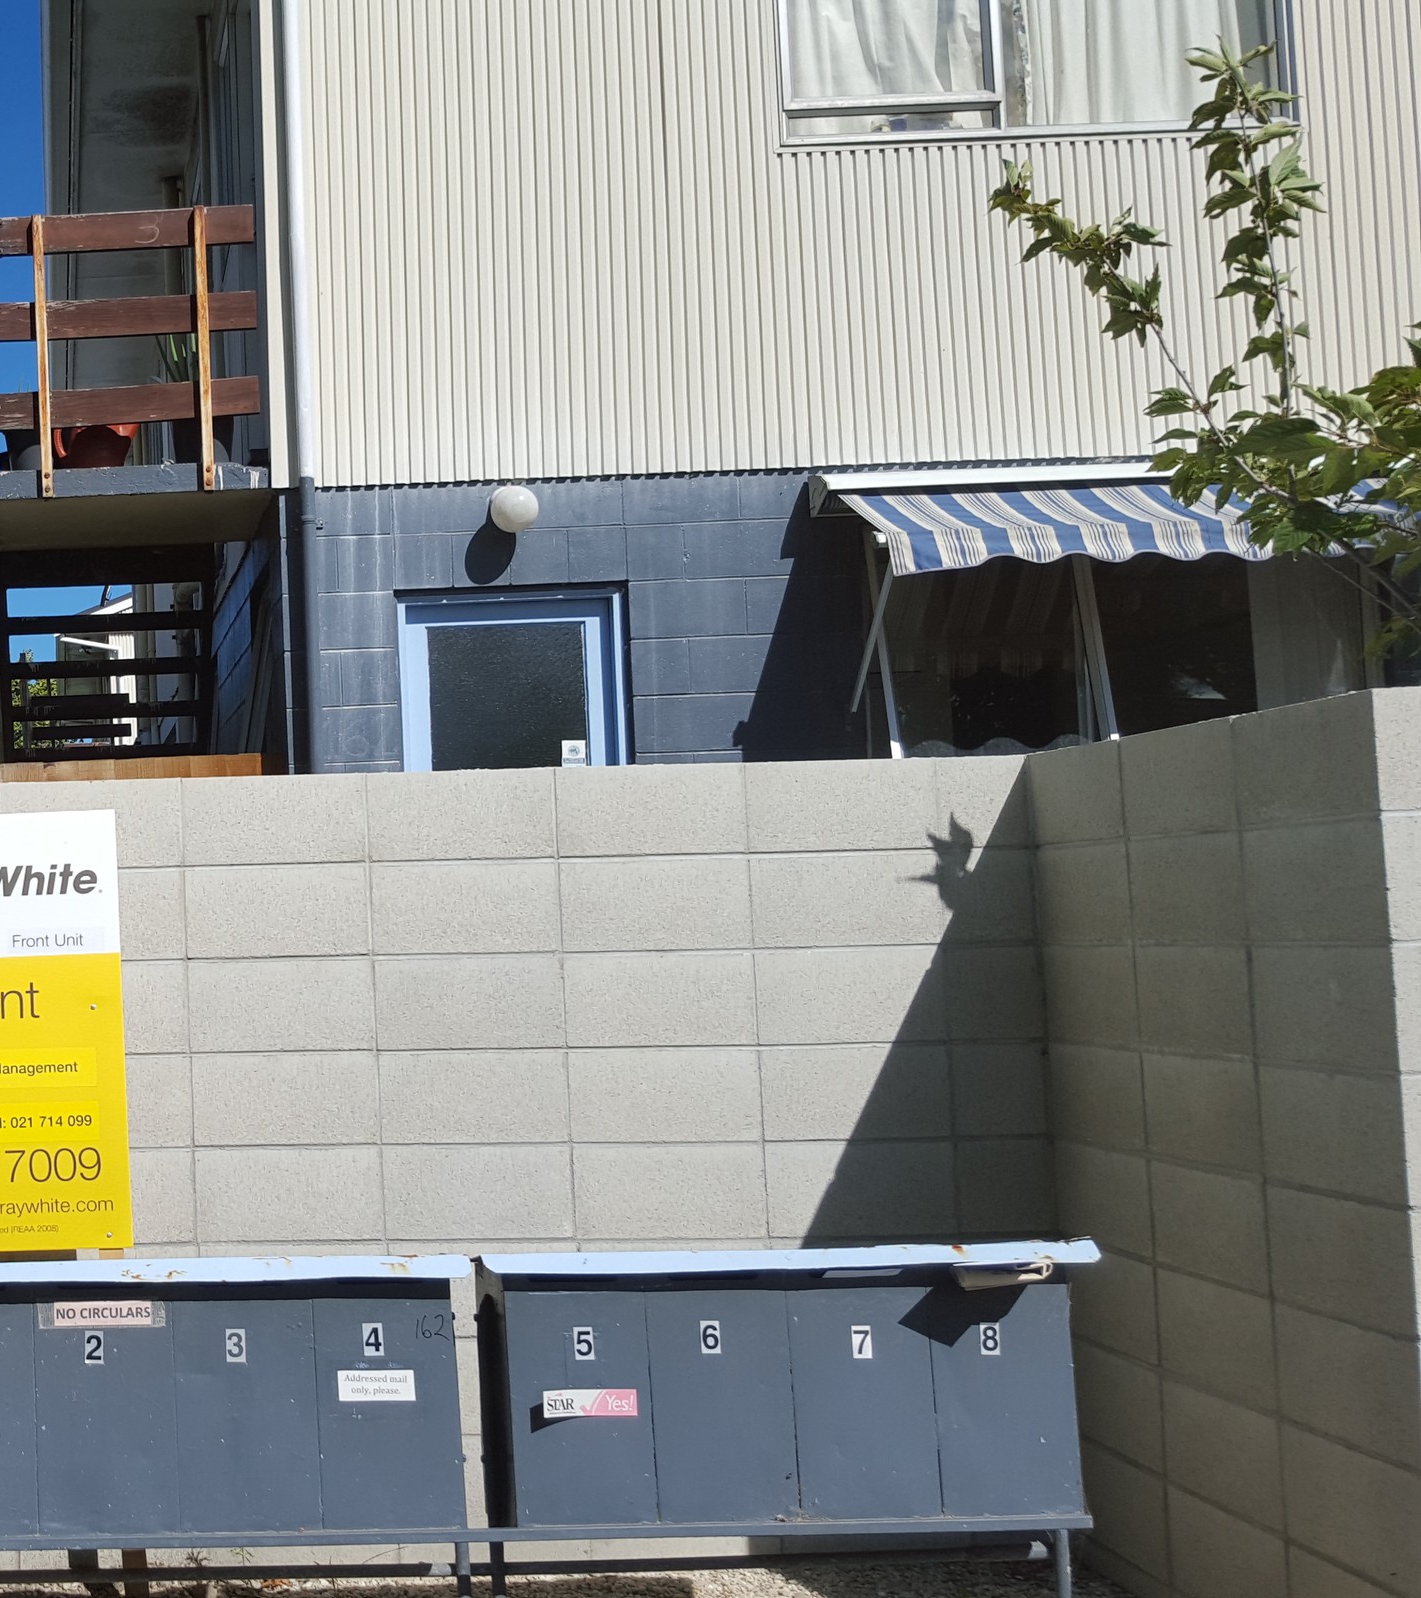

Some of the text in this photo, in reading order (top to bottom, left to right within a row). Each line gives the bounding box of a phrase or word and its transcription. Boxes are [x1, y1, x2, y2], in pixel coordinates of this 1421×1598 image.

[11, 932, 84, 948] Front Unit
[10, 1116, 33, 1128] 021
[39, 1115, 63, 1127] 714
[67, 1114, 93, 1127] 099
[5, 1146, 102, 1183] 7009
[55, 1306, 151, 1320] NO CIRCULARS
[365, 1327, 382, 1352] 4
[415, 1313, 451, 1341] 162
[701, 1324, 719, 1350] 6
[982, 1326, 999, 1351] 8
[85, 1335, 102, 1360] 2
[227, 1332, 244, 1358] 3
[576, 1330, 593, 1356] 5
[852, 1330, 869, 1355] 7
[344, 1374, 408, 1383] Addressed mail
[350, 1386, 401, 1395] only, please.
[546, 1396, 575, 1411] STAR
[605, 1395, 634, 1411] Yes!
